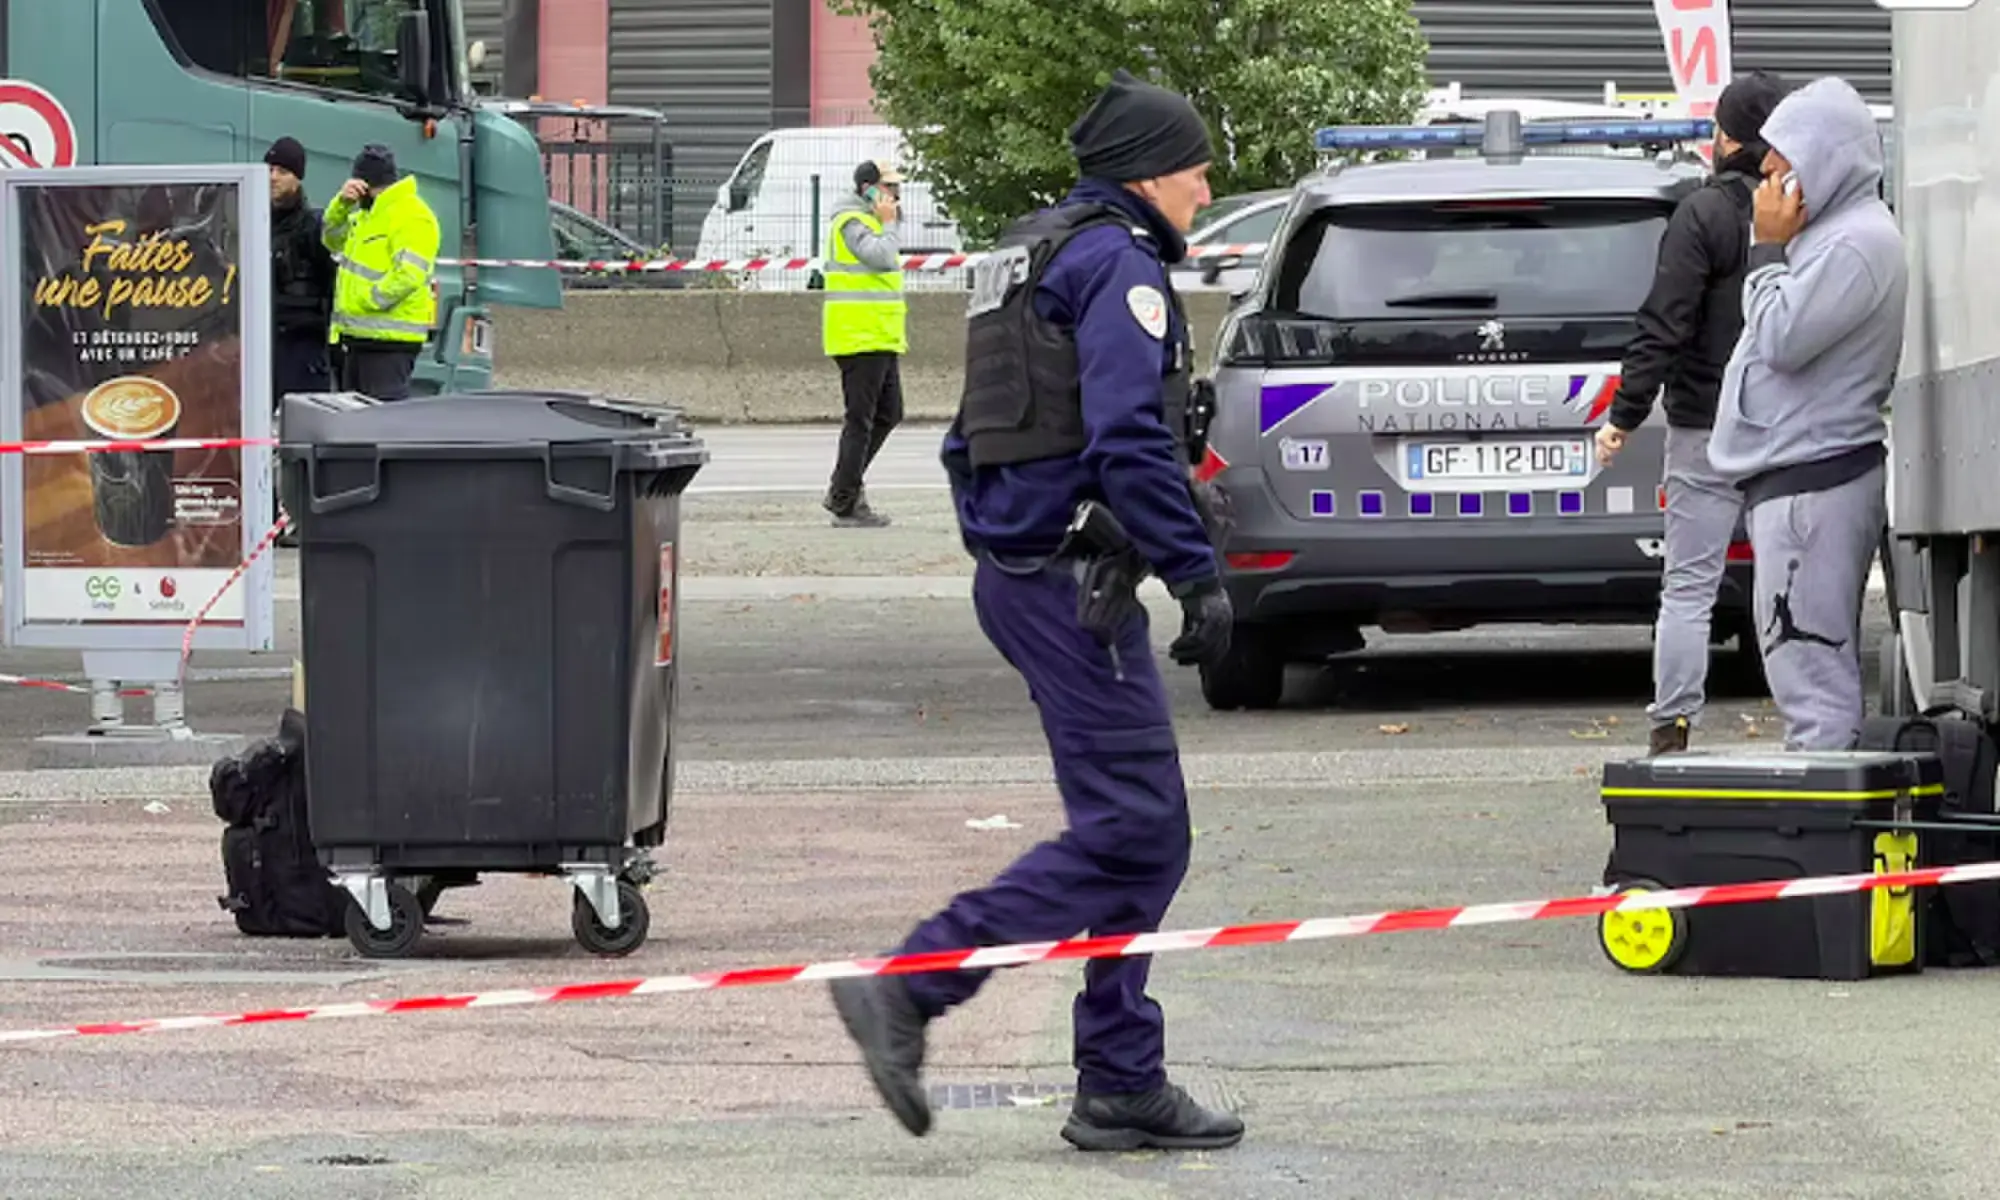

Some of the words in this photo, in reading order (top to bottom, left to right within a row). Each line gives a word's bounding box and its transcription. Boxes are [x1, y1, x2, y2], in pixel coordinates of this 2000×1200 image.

[82, 219, 194, 273] Faites
[33, 274, 101, 308] une
[103, 274, 214, 320] pause
[220, 262, 237, 304] !
[1357, 375, 1551, 408] POLICE
[1358, 410, 1551, 432] NATIONALE
[1300, 444, 1324, 464] 17
